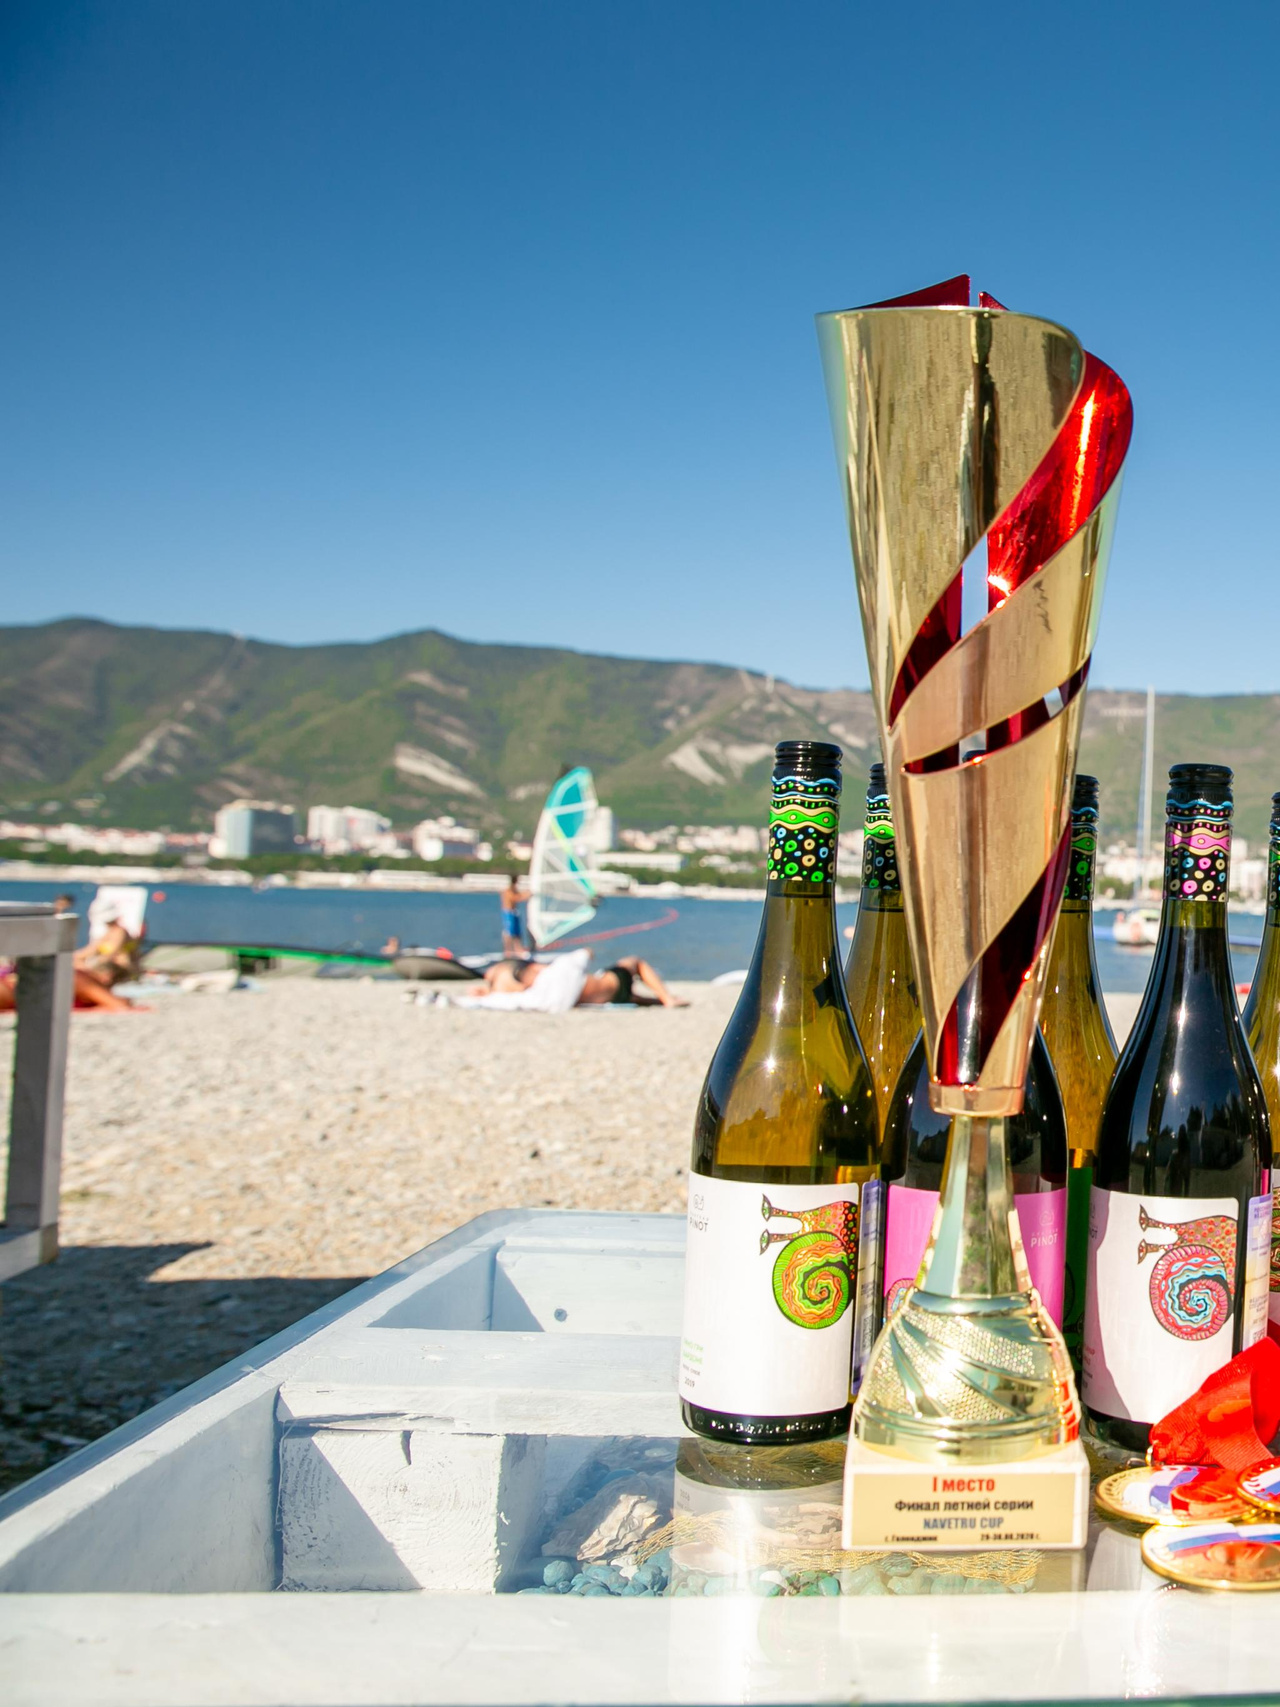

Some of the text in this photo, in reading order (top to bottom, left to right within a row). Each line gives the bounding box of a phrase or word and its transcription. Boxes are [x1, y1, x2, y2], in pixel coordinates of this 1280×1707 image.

[1030, 1233, 1058, 1248] PINOT
[942, 1478, 996, 1492] место
[895, 1499, 1034, 1513] Финал летней серии
[923, 1516, 1004, 1530] NAVETRU CUP
